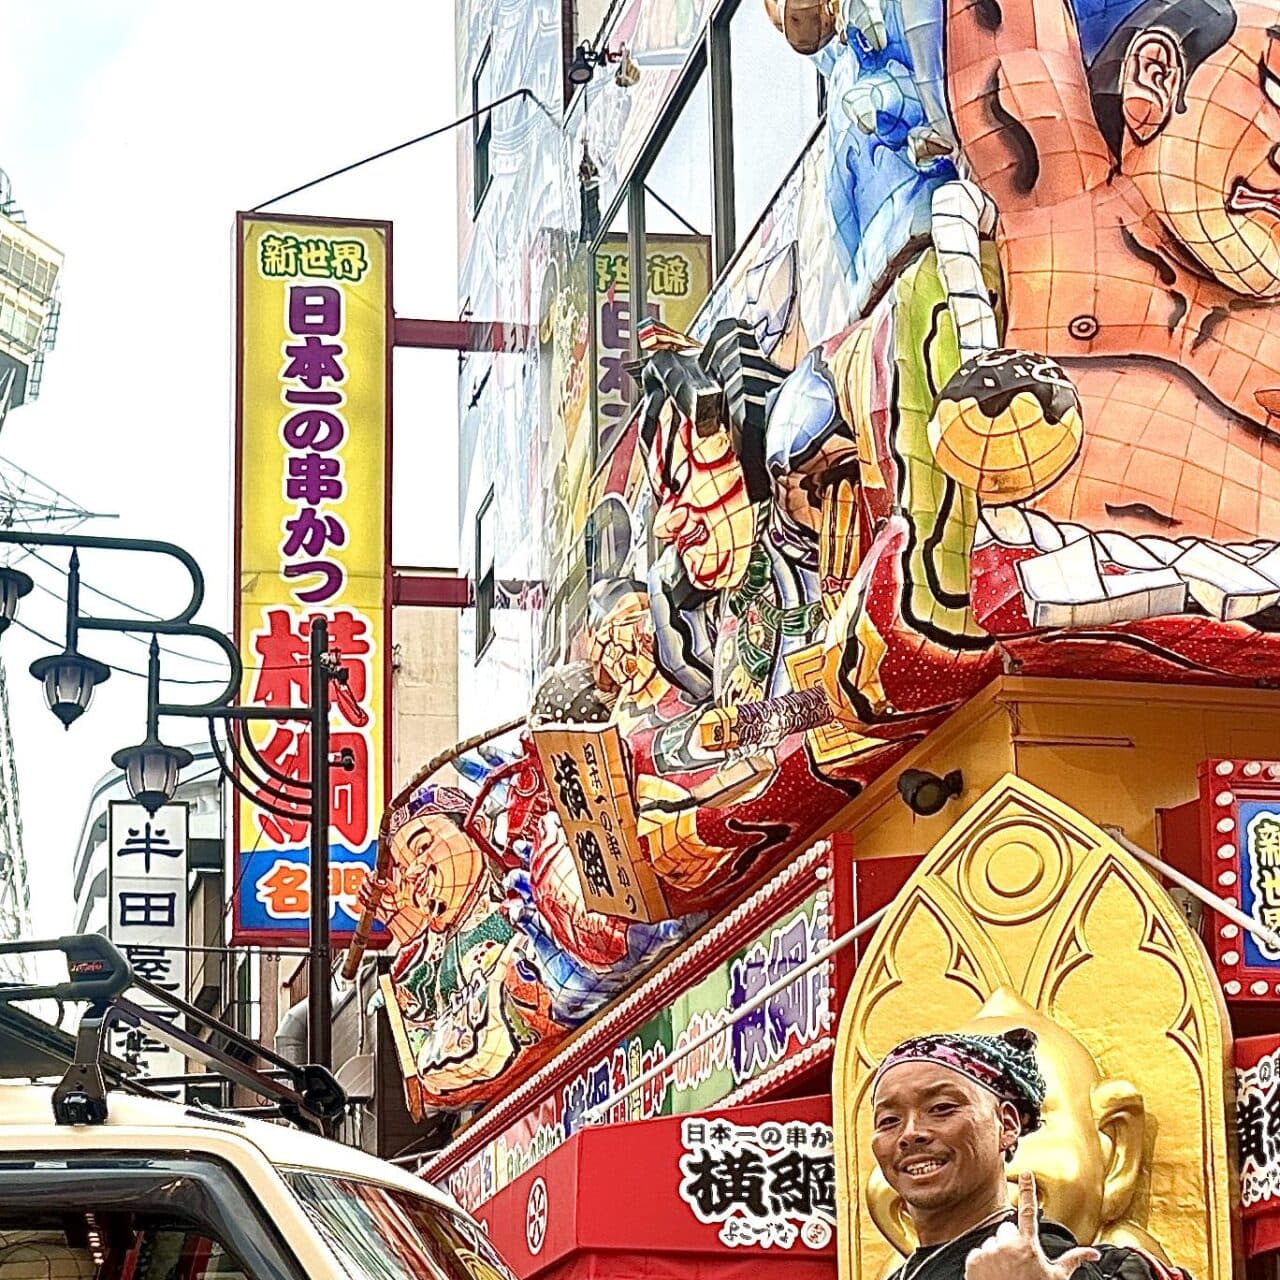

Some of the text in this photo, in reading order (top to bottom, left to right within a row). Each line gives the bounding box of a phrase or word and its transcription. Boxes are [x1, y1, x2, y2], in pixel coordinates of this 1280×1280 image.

[261, 234, 368, 280] 新世界
[283, 285, 345, 602] 日本一の串かつ
[686, 1148, 836, 1217] 横綱
